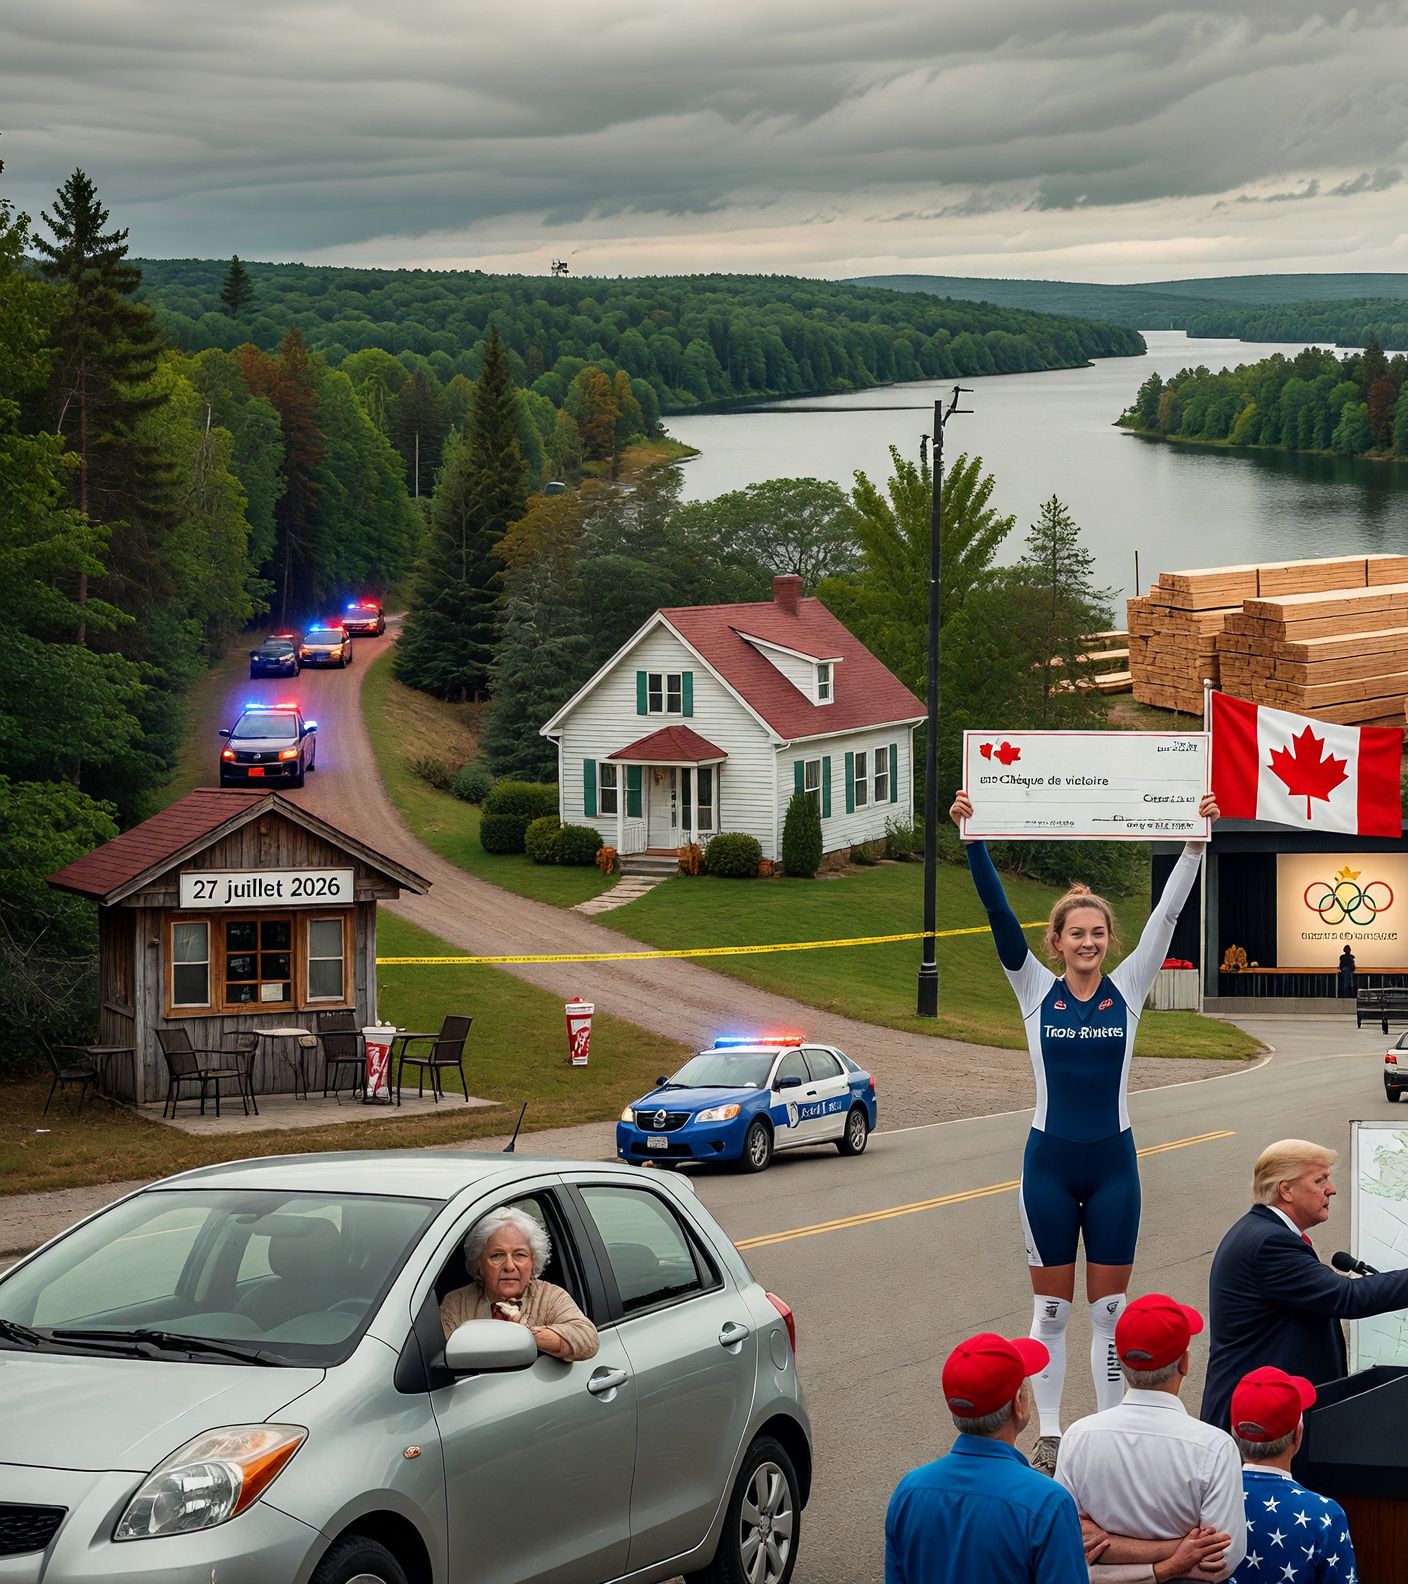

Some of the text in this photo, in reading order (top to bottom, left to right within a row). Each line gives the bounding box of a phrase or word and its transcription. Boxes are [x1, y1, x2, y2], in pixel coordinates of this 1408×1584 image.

[1047, 775, 1062, 786] de
[1065, 775, 1109, 786] victoire
[193, 877, 341, 904] 27 juillet 2026
